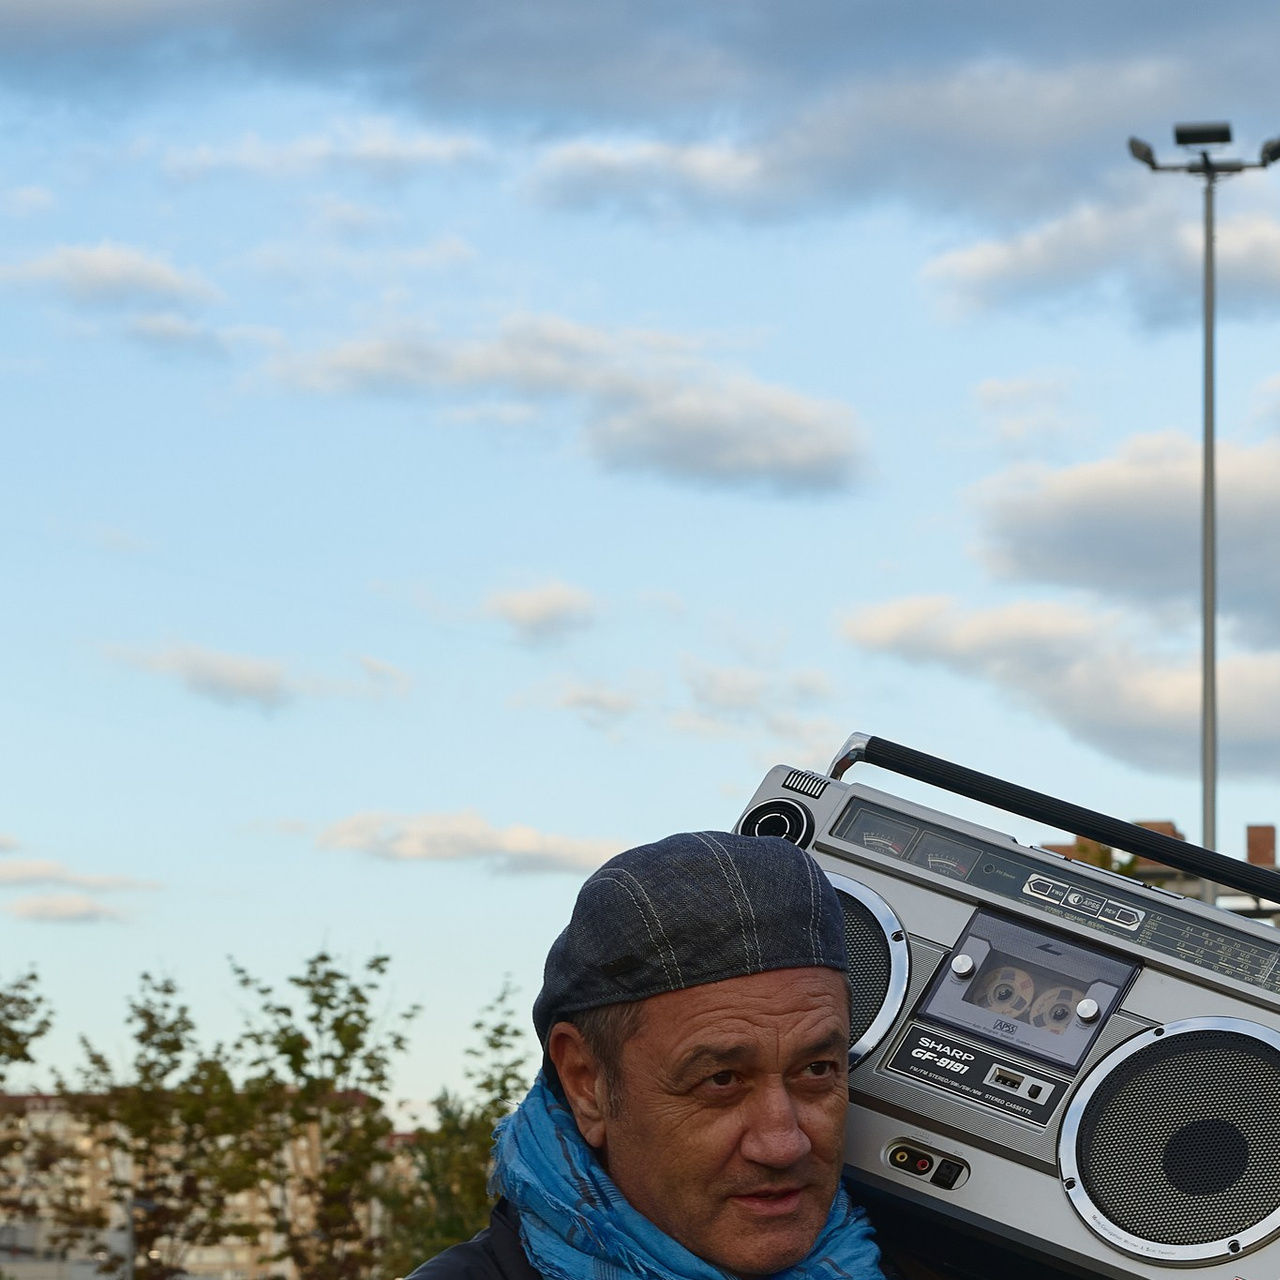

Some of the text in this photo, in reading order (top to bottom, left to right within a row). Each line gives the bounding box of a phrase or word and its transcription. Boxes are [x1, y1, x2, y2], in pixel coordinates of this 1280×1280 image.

[1082, 899, 1101, 910] APSS
[994, 1020, 1017, 1034] APSS
[918, 1036, 975, 1062] SHARP
[911, 1048, 970, 1075] GF-9191
[984, 1093, 1005, 1105] STEREO
[1005, 1100, 1033, 1116] CASSETTE
